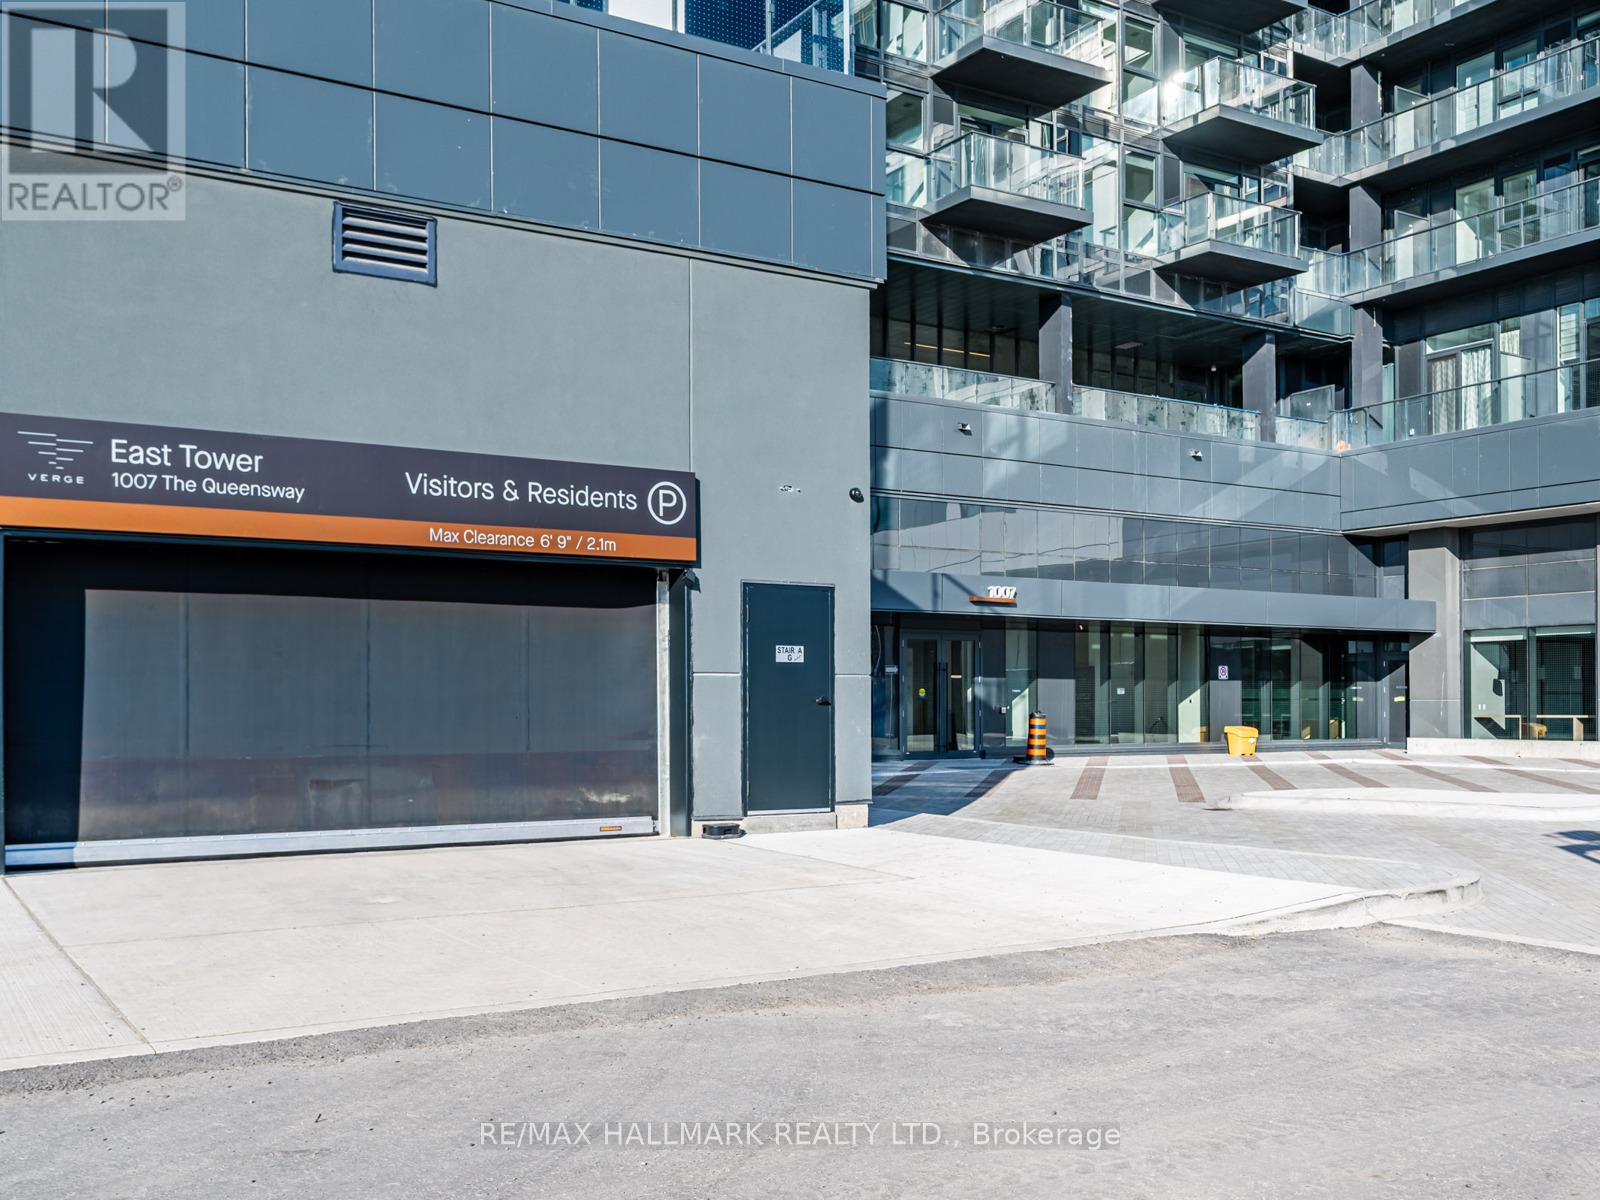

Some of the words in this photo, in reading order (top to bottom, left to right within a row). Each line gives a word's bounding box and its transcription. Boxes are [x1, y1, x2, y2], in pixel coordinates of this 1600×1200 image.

[110, 439, 172, 466] East
[179, 443, 263, 473] Tower
[27, 473, 85, 485] VERGE
[112, 471, 157, 489] 1007
[161, 475, 197, 493] The
[202, 477, 305, 503] Queensway
[404, 471, 495, 500] Visitors
[502, 479, 520, 501] &
[527, 481, 638, 511] Residents
[429, 527, 460, 544] Max
[463, 529, 535, 548] Clearance
[540, 534, 553, 548] 6'
[557, 535, 572, 549] 9"
[575, 535, 583, 550] /
[586, 536, 617, 552] 2.1m
[987, 585, 1017, 599] 1007
[776, 646, 795, 654] STAIR
[797, 646, 803, 654] A
